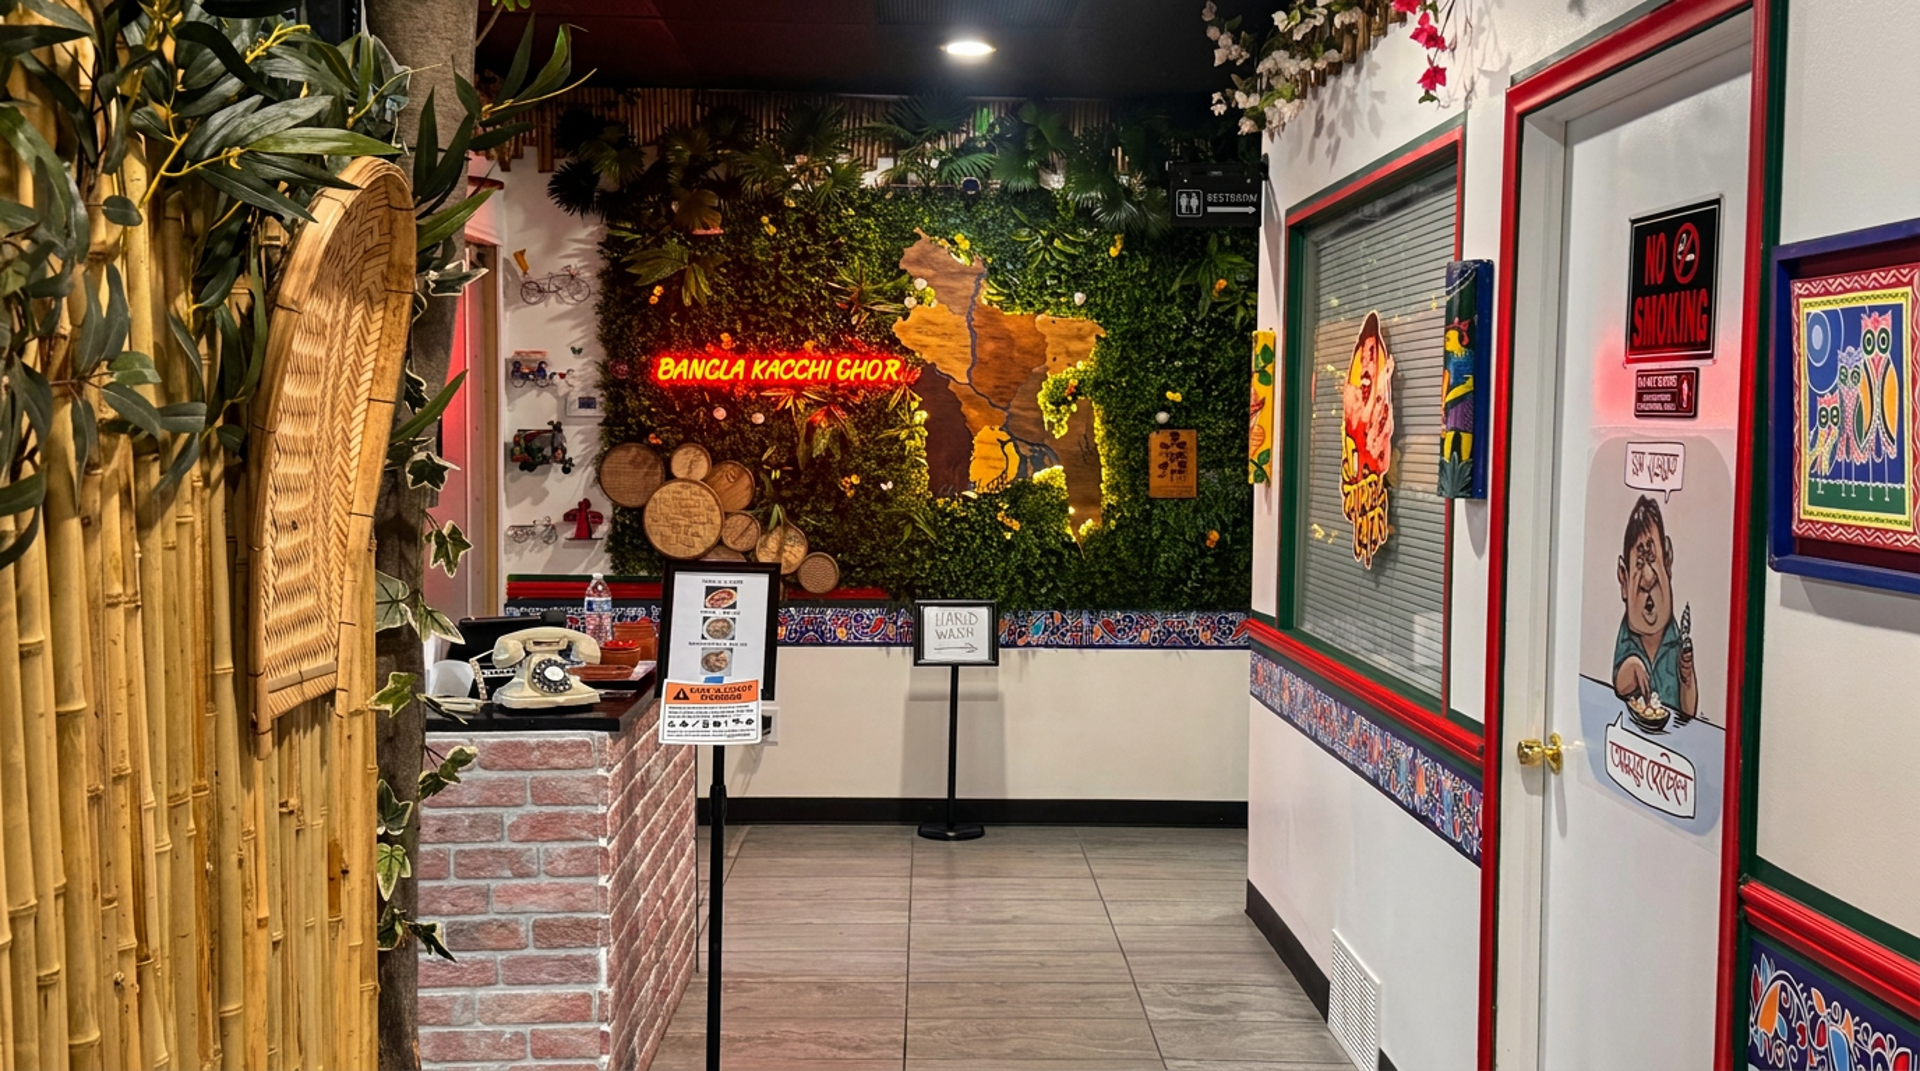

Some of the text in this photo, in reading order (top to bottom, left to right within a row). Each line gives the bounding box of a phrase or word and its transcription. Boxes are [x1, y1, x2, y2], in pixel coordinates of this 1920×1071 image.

[1644, 232, 1667, 286] NO
[1632, 287, 1709, 347] SMOKING
[657, 357, 745, 381] BANGLA
[750, 358, 833, 381] KACCHI
[935, 627, 975, 640] WASH
